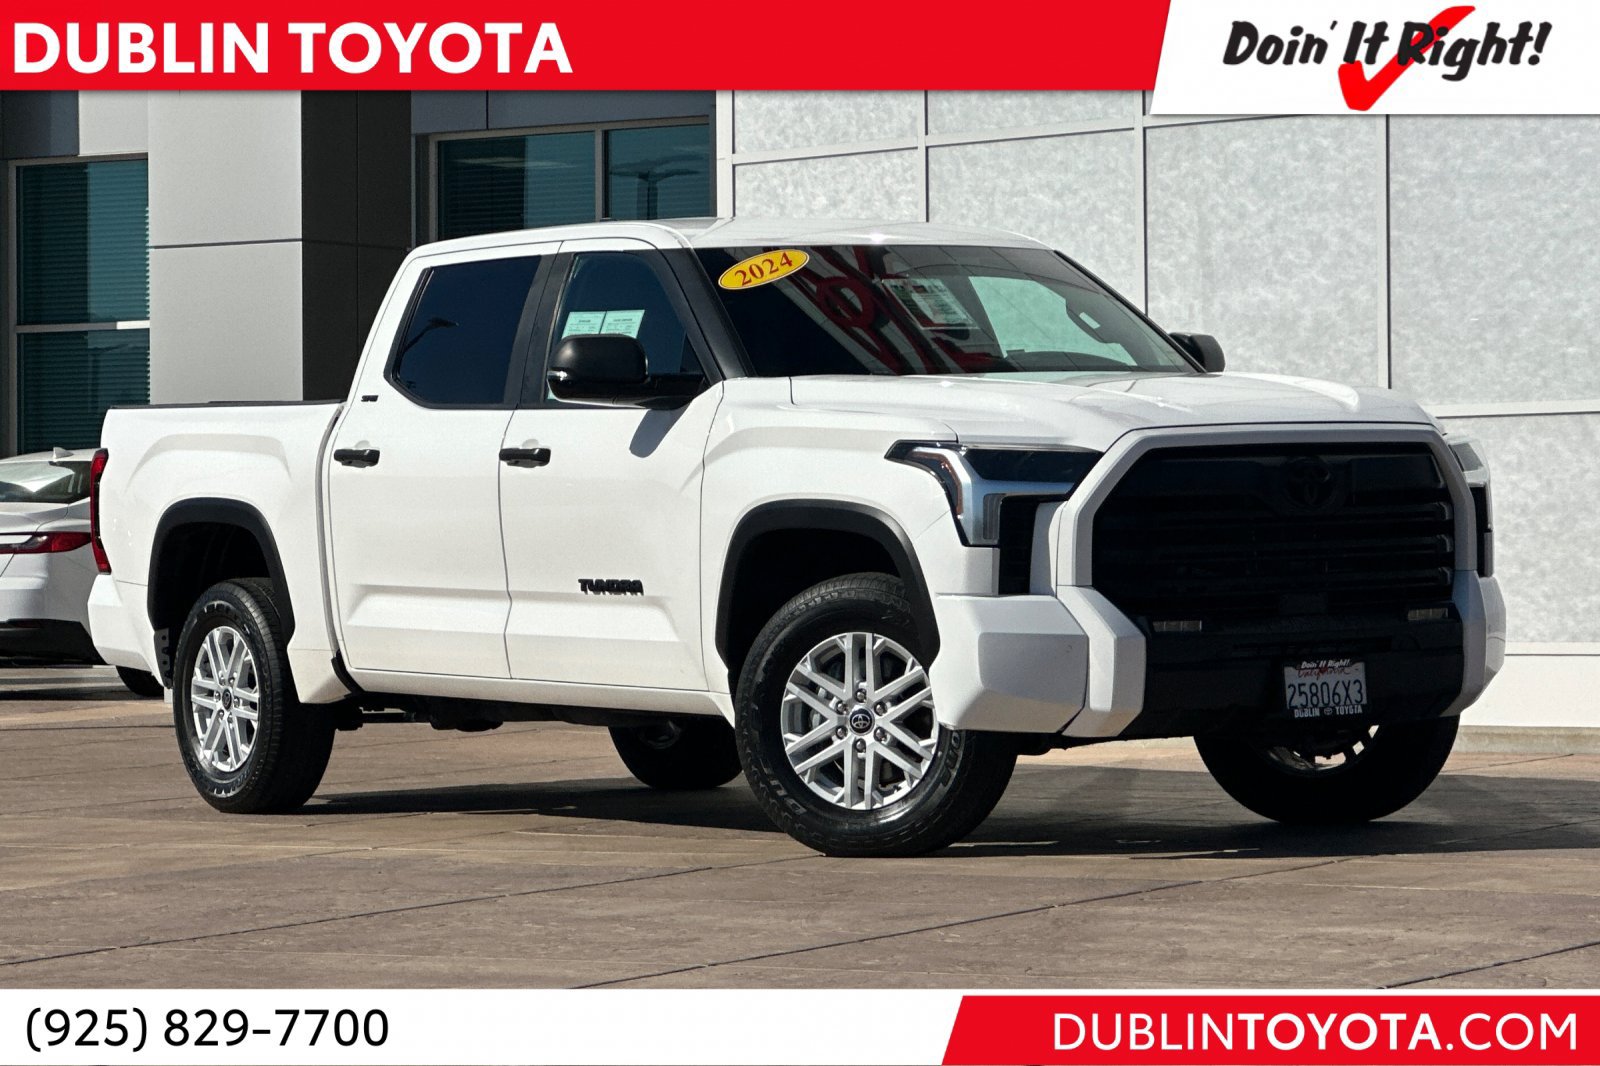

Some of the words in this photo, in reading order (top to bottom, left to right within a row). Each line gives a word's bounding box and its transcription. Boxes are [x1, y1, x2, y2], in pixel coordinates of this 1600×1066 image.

[734, 251, 793, 286] 2024
[578, 579, 644, 595] TUNDRA
[1287, 679, 1363, 710] 25806X3
[1294, 707, 1321, 718] DUBLIN
[1335, 704, 1363, 715] TOYOTA
